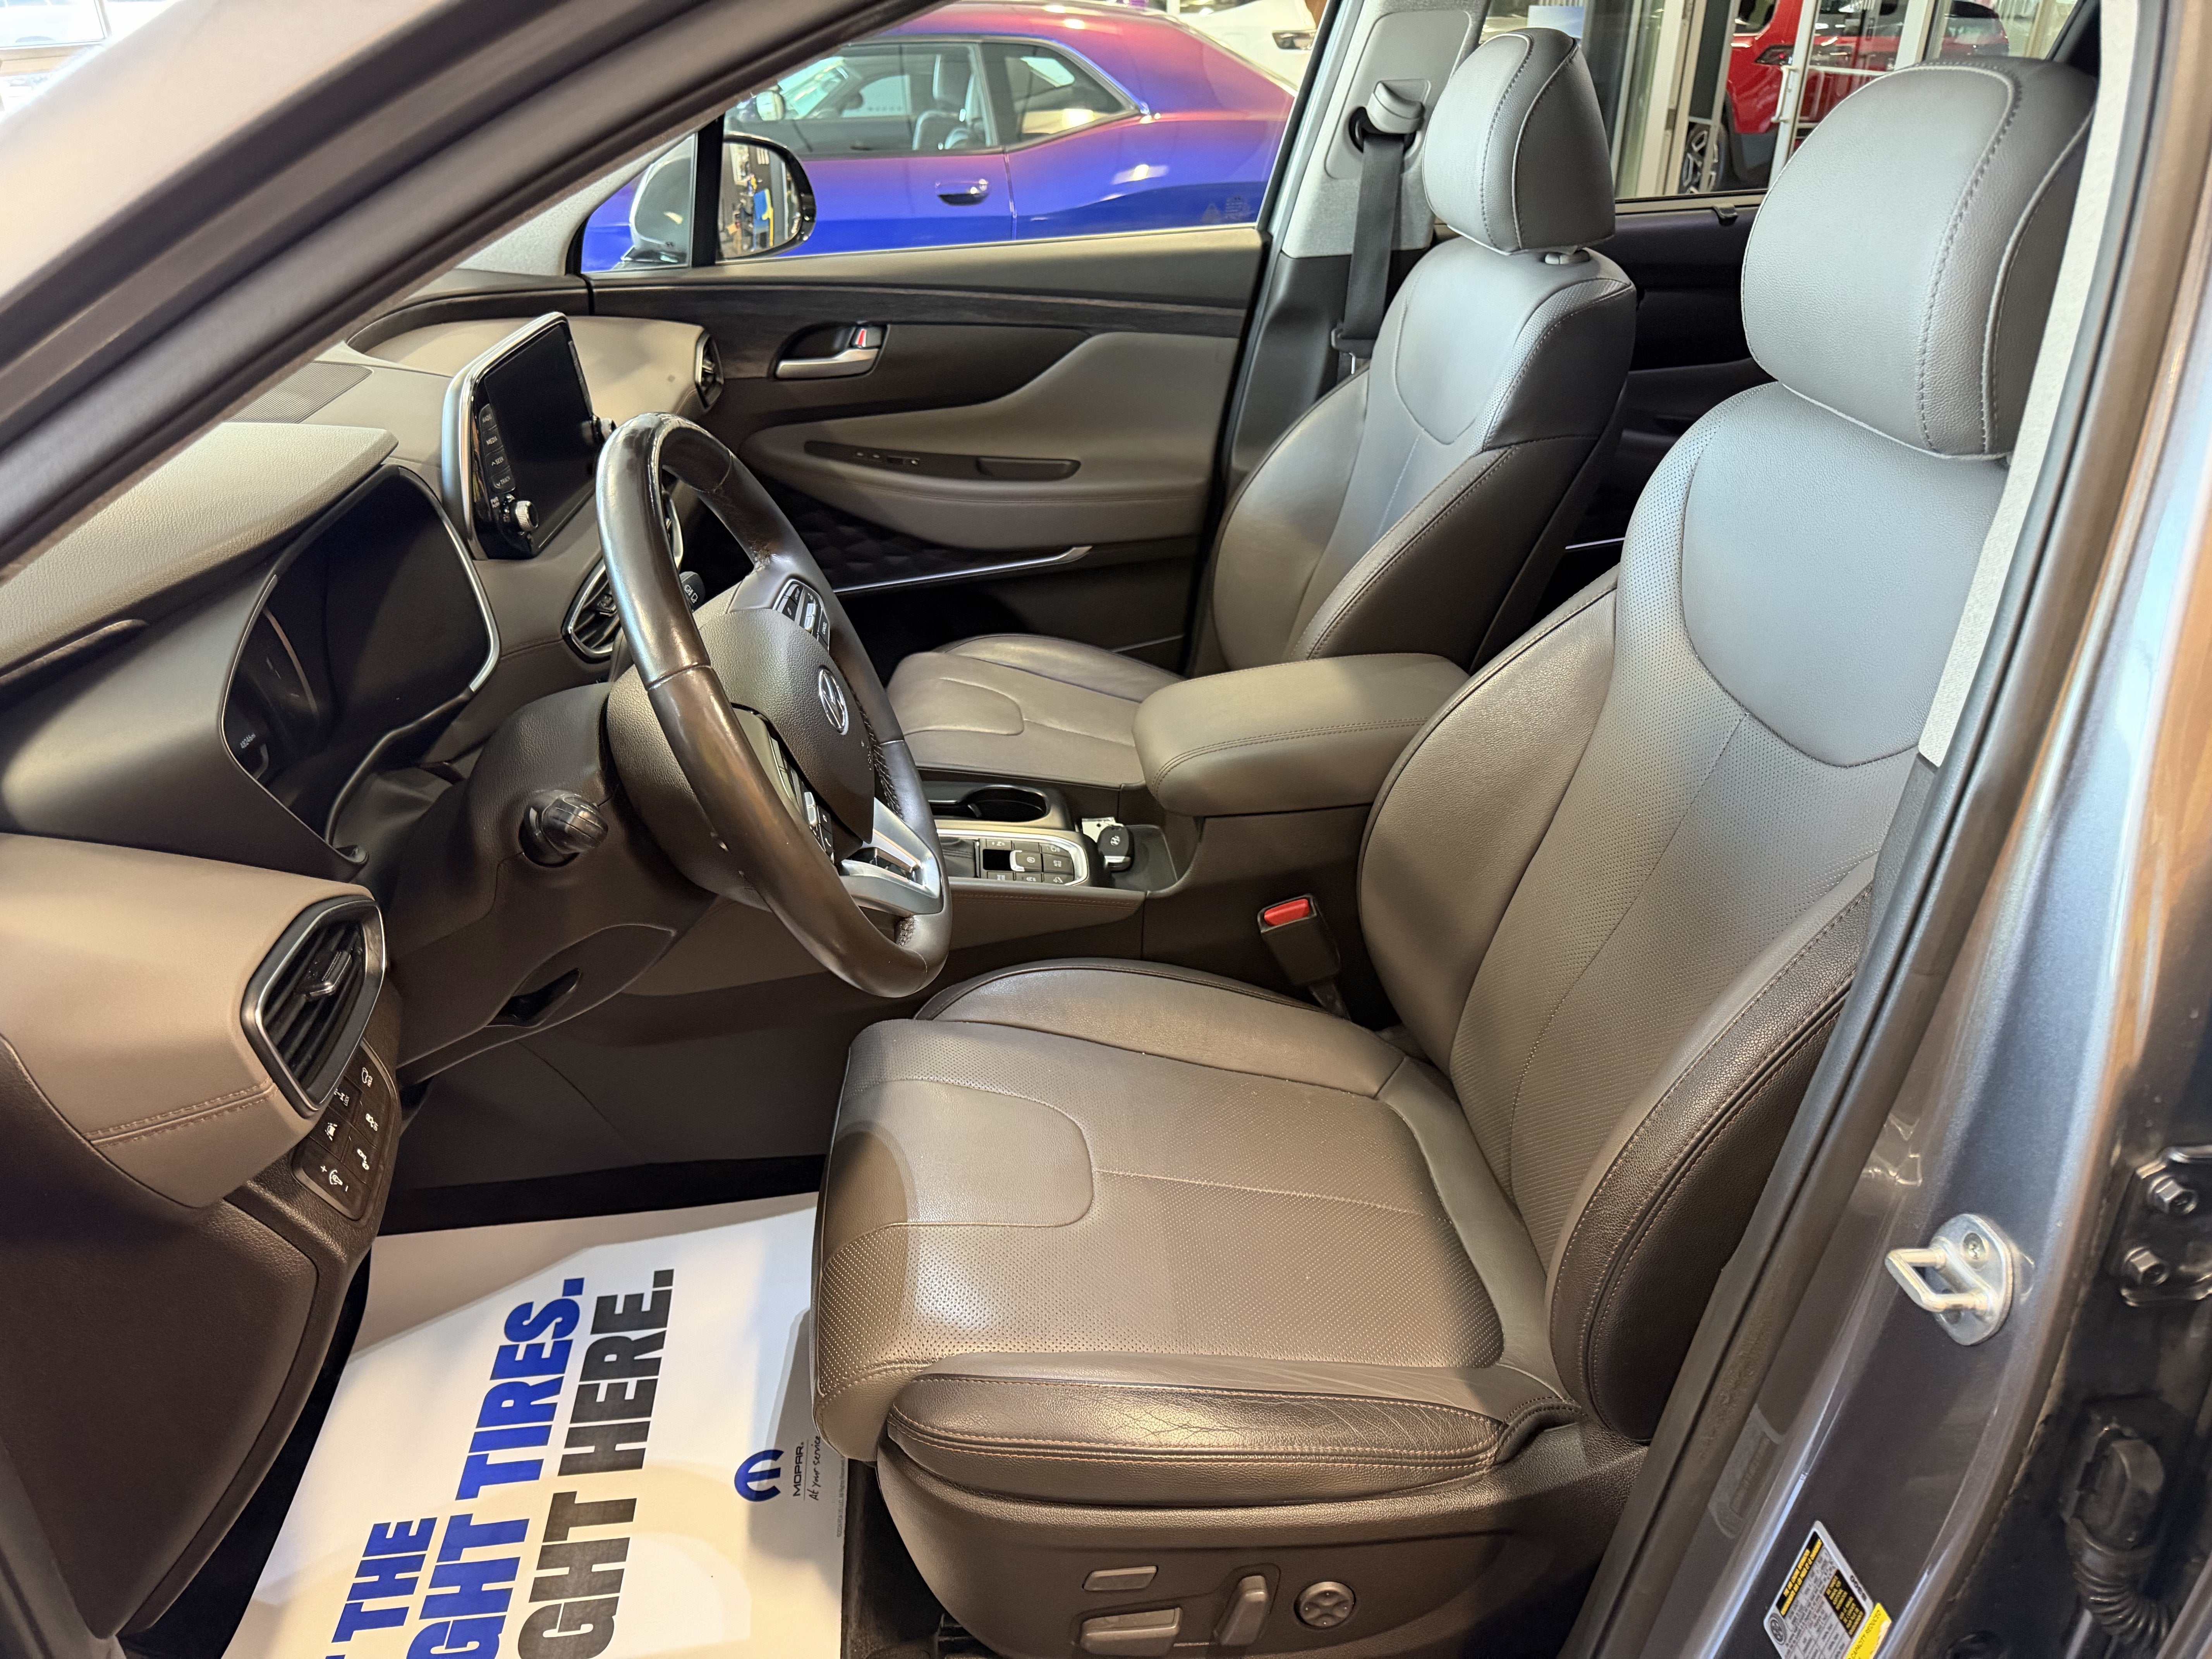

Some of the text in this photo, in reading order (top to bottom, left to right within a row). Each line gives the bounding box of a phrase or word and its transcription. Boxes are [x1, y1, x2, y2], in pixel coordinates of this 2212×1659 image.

[486, 436, 498, 446] MEDIA
[456, 1278, 585, 1501] TIRES.
[557, 1268, 675, 1477] HERE.
[807, 1436, 821, 1501] At your service
[331, 1516, 438, 1643] THE
